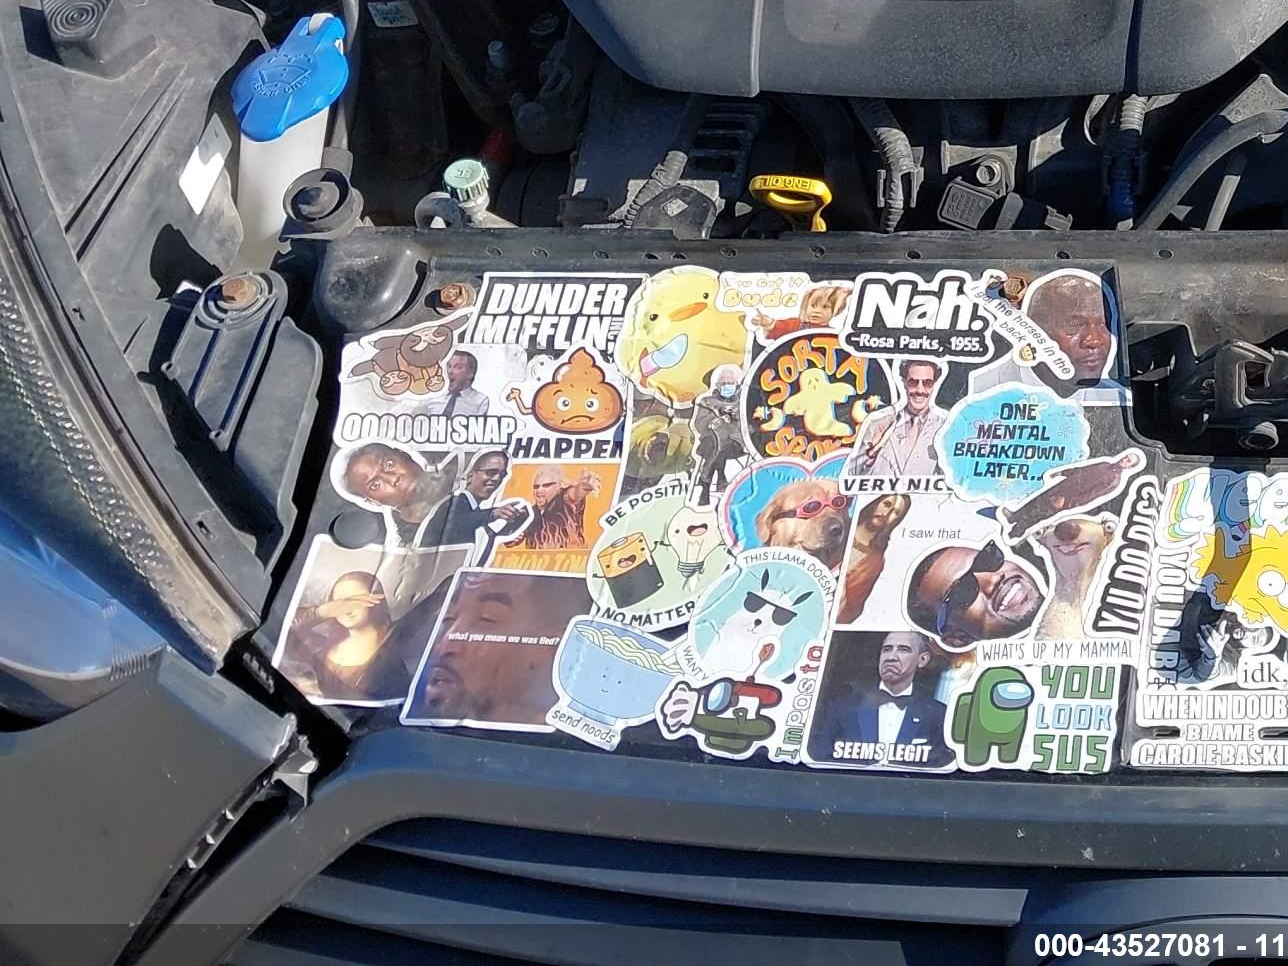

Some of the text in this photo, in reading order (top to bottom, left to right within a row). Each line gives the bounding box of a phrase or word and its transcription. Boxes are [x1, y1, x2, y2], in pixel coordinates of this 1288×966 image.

[486, 283, 628, 315] DUNDER
[722, 288, 799, 308] Dude
[857, 280, 985, 331] Nah.
[900, 335, 944, 352] Parks,
[951, 335, 983, 351] 1955.
[994, 300, 1013, 318] the
[1013, 314, 1047, 346] horses
[1043, 345, 1057, 357] in
[1053, 357, 1072, 375] the
[999, 320, 1028, 343] back
[760, 336, 870, 406] SORTA
[999, 402, 1038, 422] ONE
[450, 415, 517, 444] SNAP
[976, 422, 1051, 442] MENTAL
[953, 442, 1066, 462] BREAKDOWN
[843, 477, 954, 492] VERY NIC
[605, 507, 627, 527] BE
[909, 529, 934, 538] saw
[938, 527, 961, 538] that
[742, 551, 769, 565] THIS
[772, 551, 807, 568] LLAMA
[1113, 546, 1151, 588] DO
[1155, 551, 1190, 604] YOU
[602, 600, 695, 626] NO MATTER
[1097, 586, 1145, 632] YU
[448, 632, 469, 641] what
[469, 633, 483, 642] you
[484, 635, 507, 643] mean
[539, 636, 561, 645] tied?
[982, 642, 1026, 662] WHAT'S
[1032, 640, 1048, 659] UP
[1053, 641, 1074, 660] MY
[1041, 664, 1117, 700] YOU
[1242, 661, 1288, 688] idk,
[1035, 702, 1113, 731] LOOK
[1143, 694, 1202, 720] WHEN
[1206, 694, 1229, 720] IN
[551, 708, 616, 745] send noods
[1185, 723, 1255, 742] BLAME
[832, 740, 932, 763] SEEMS LEGIT
[1030, 734, 1110, 772] SUS
[1139, 742, 1219, 766] CAROLE
